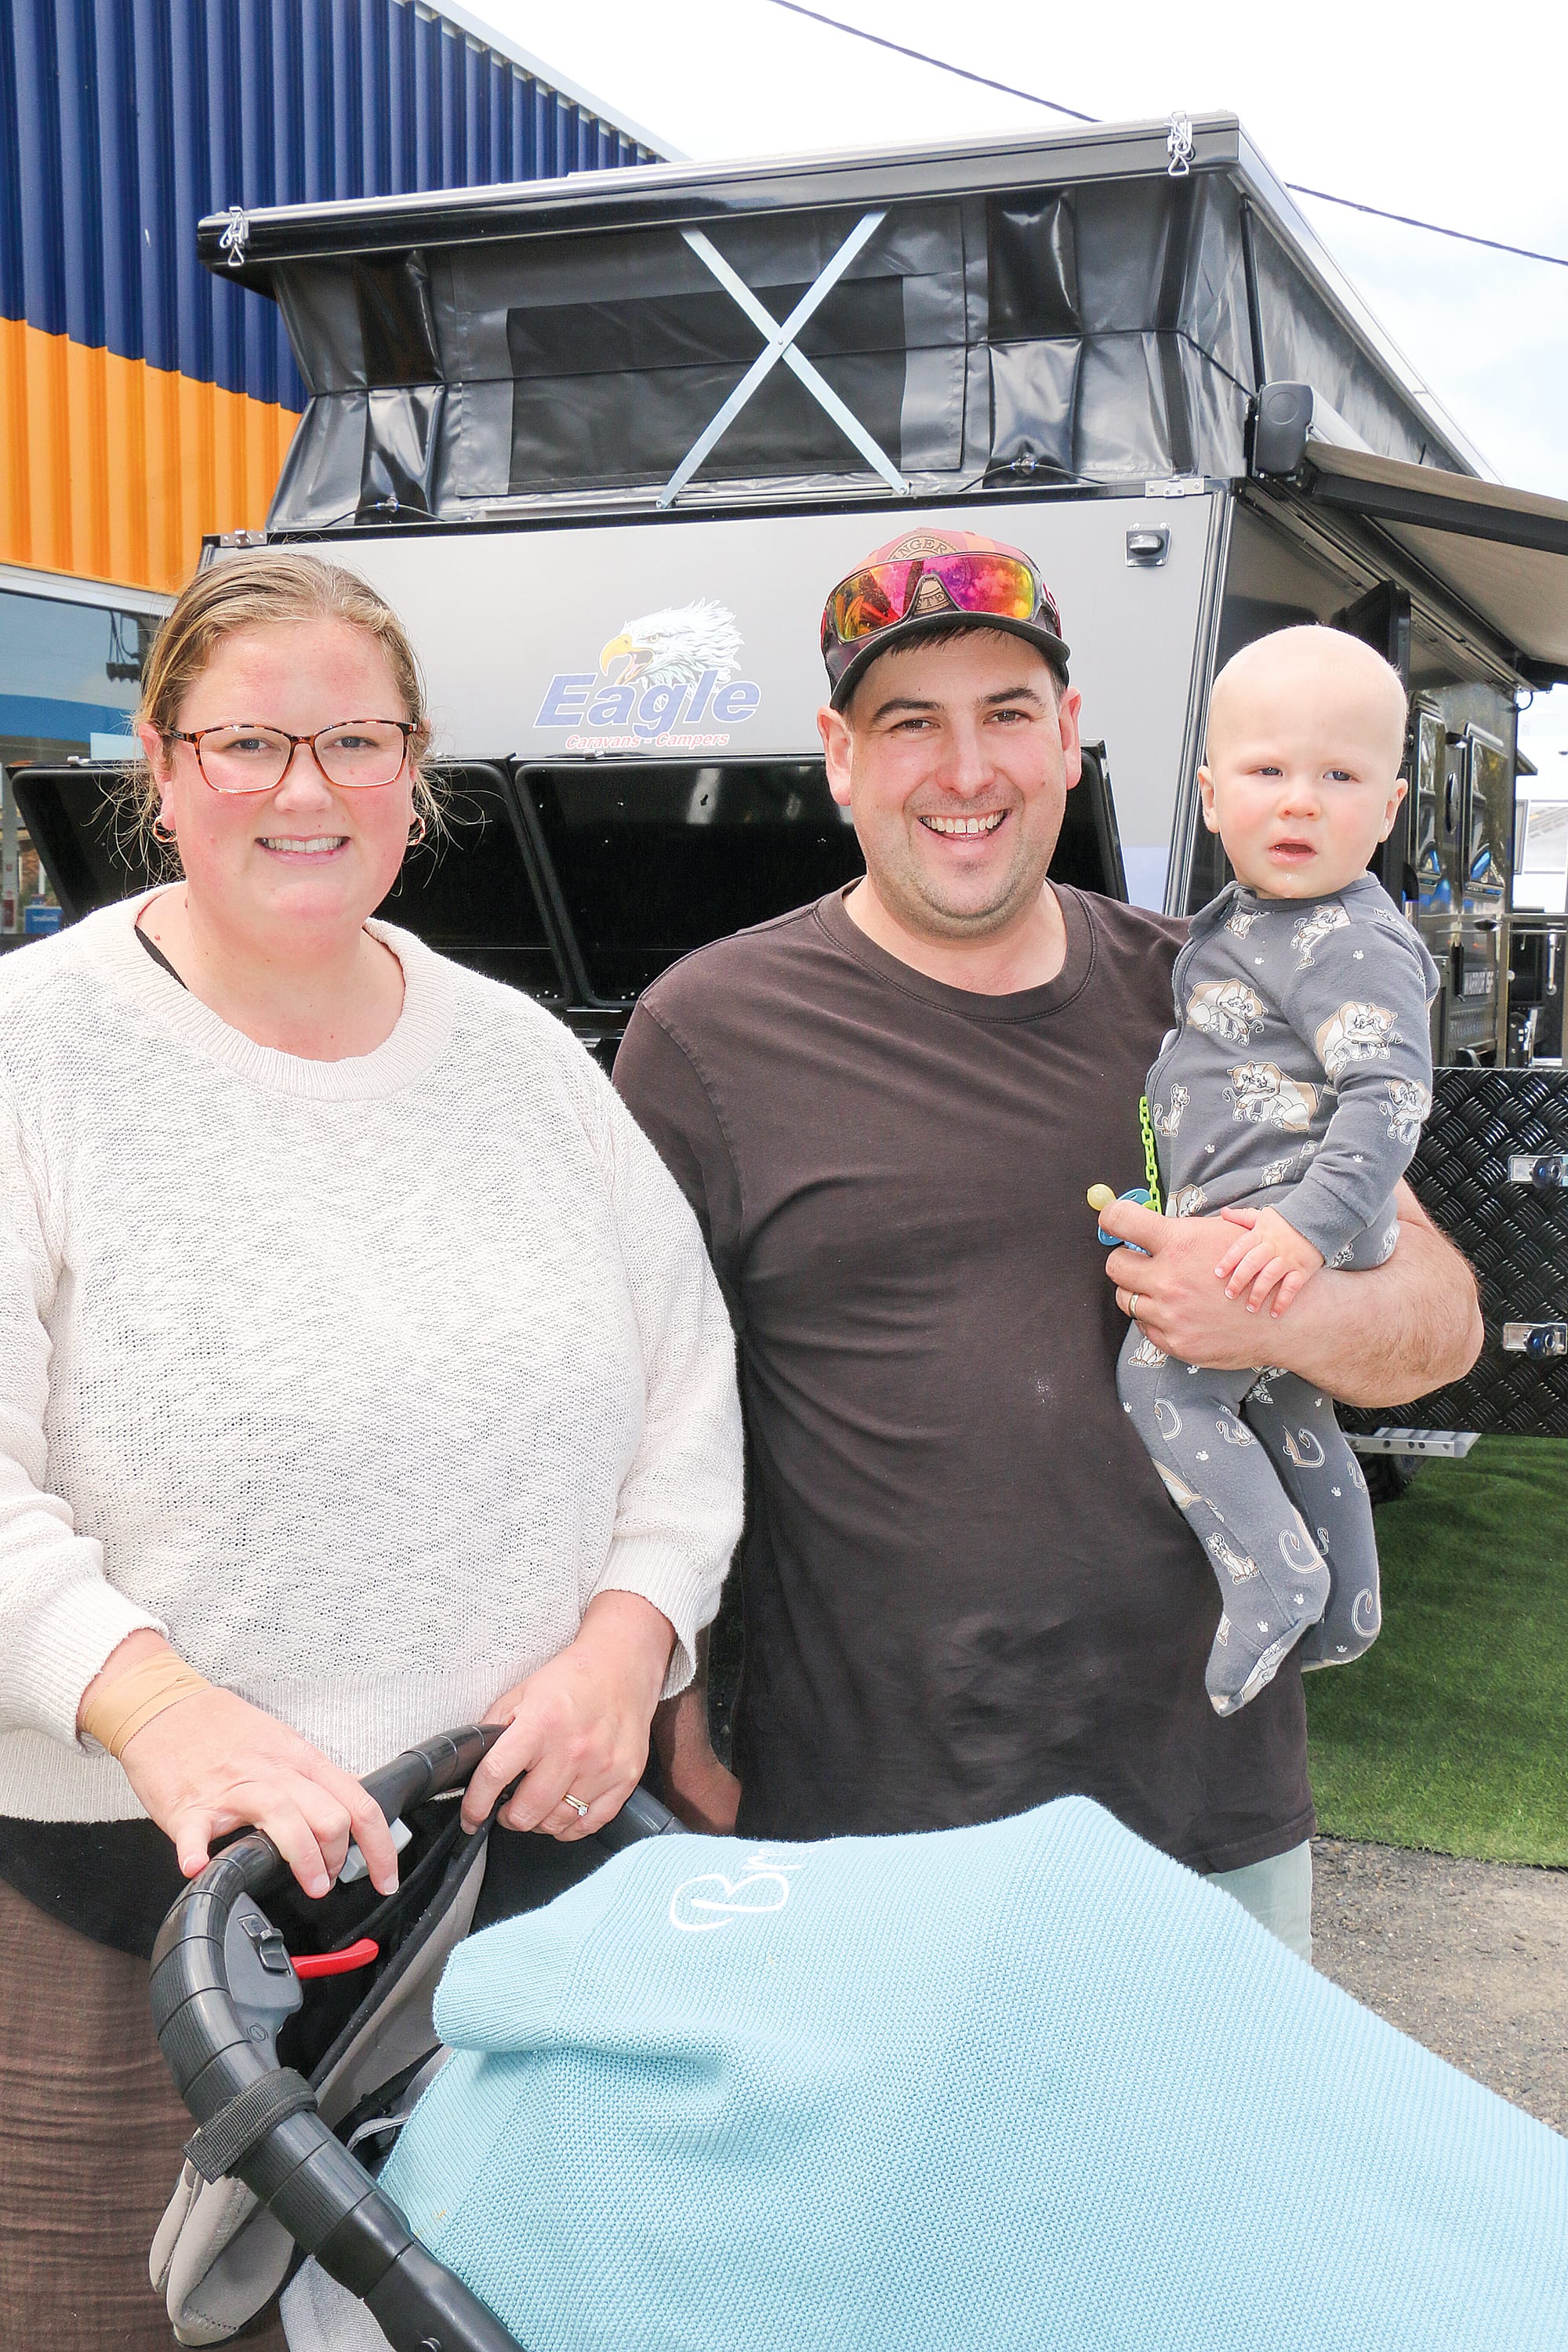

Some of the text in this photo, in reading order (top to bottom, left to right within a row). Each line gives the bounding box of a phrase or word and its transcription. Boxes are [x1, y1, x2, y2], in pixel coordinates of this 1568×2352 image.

[533, 670, 761, 738] Eagle
[565, 735, 640, 749] Caravans
[655, 733, 730, 750] Campers
